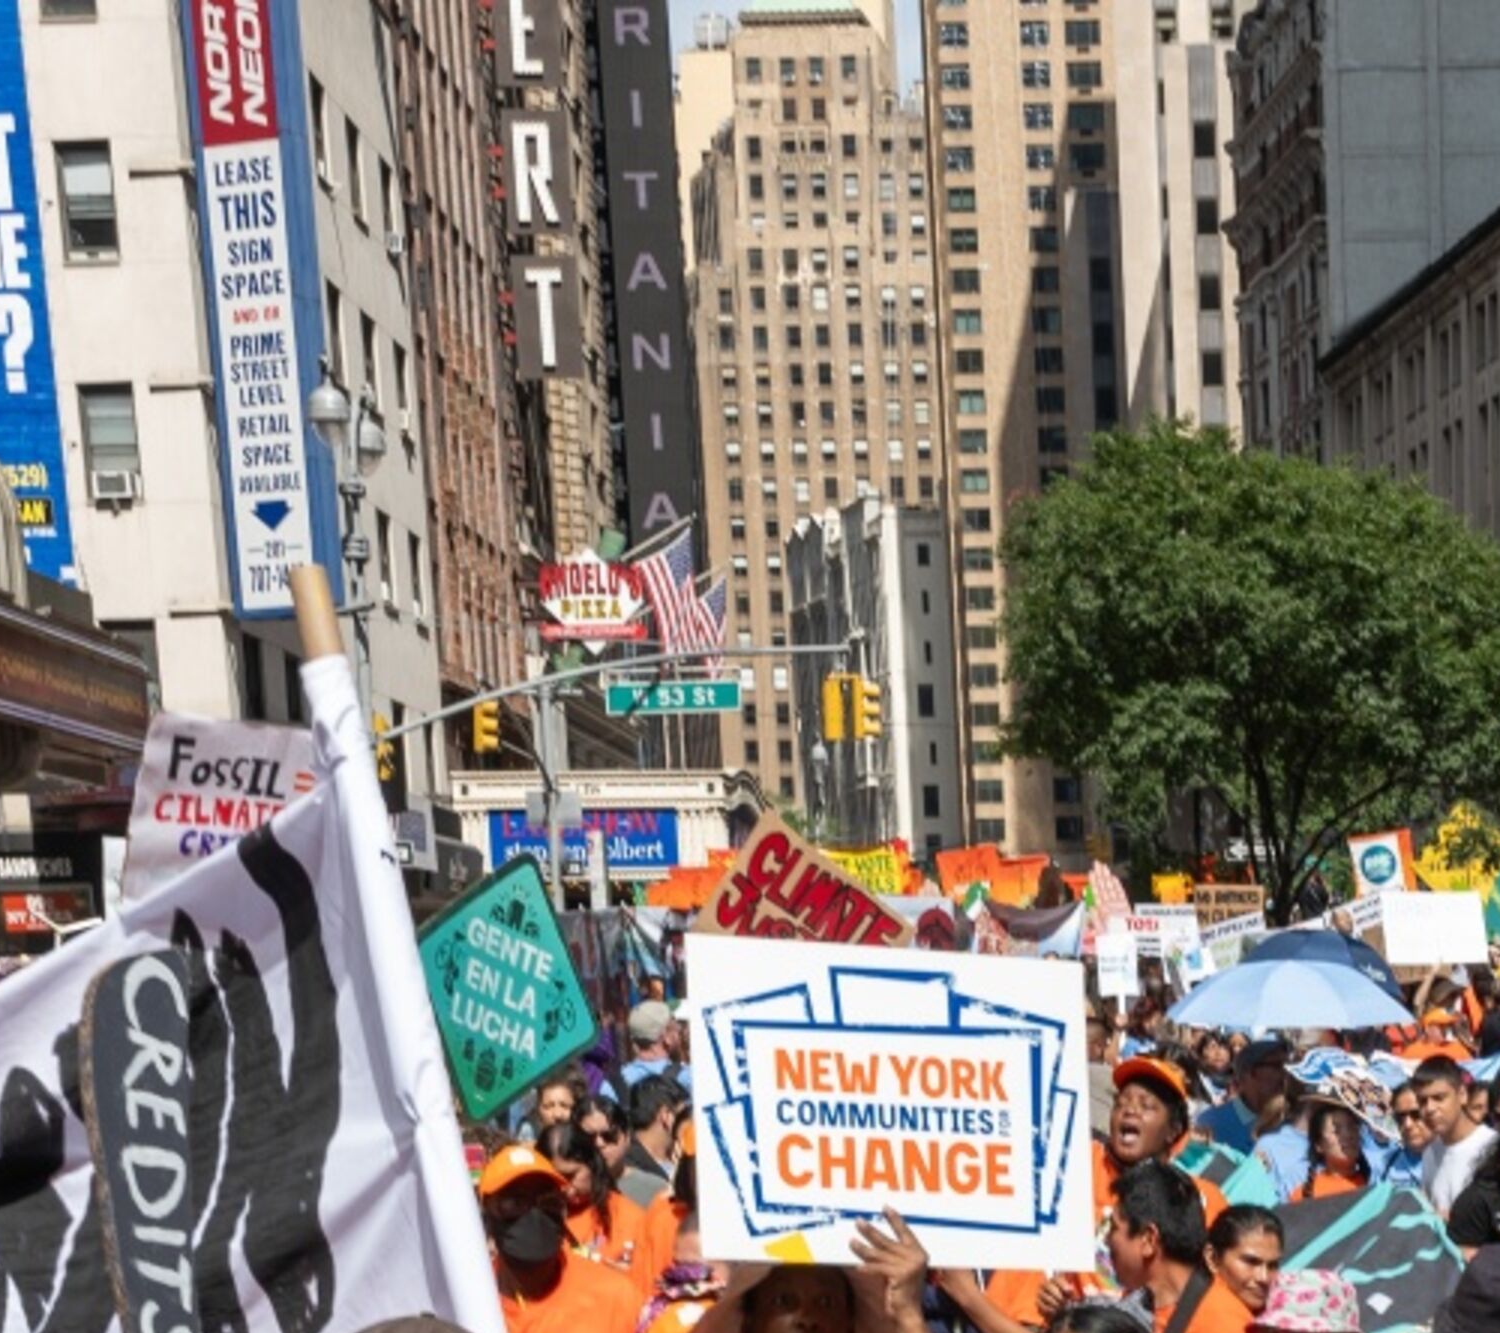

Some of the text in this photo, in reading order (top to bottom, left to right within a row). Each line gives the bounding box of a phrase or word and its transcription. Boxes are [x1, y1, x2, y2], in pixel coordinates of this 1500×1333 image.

[214, 157, 273, 187] LEASE
[219, 191, 276, 230] THIS
[227, 237, 273, 266] SIGN
[221, 269, 284, 300] SPACE
[231, 331, 285, 359] PRIME
[231, 359, 289, 384] STREET
[239, 384, 284, 407] LEVEL
[238, 414, 291, 438] RETAIL
[243, 444, 292, 467] SPACE
[239, 471, 302, 494] AVAILABLE
[560, 599, 622, 619] PIZZA
[692, 686, 716, 706] St
[747, 831, 902, 945] CLIMATE
[467, 918, 553, 982] GENTE
[466, 958, 536, 1019] EN LA
[452, 991, 537, 1060] LUCHA
[775, 1049, 1007, 1102] NEW YORK
[777, 1100, 994, 1134] COMMUNITIES
[120, 957, 197, 1308] CREDIT
[777, 1134, 1014, 1196] CHANGE
